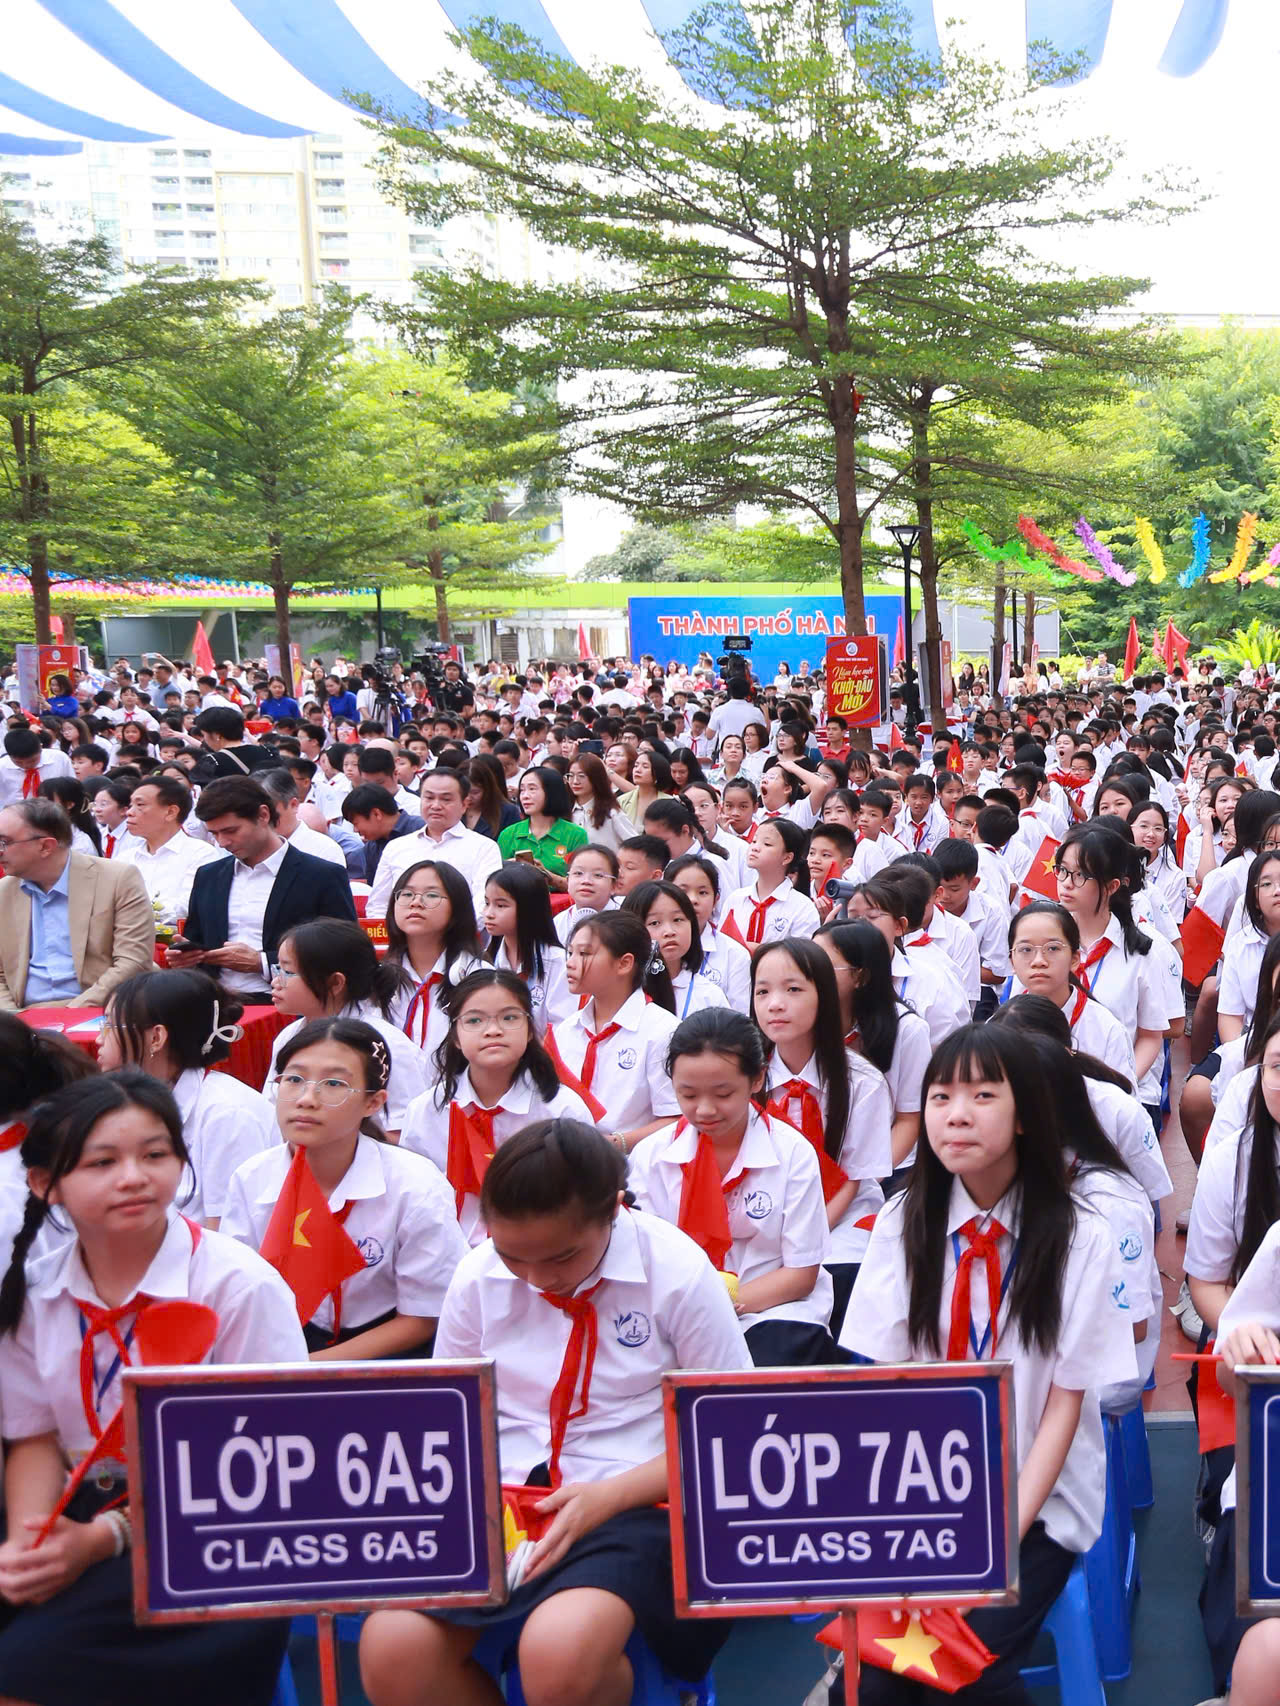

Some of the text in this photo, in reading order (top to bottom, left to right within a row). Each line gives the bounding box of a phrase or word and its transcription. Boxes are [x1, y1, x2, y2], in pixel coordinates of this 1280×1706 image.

[658, 608, 876, 635] THÀNH PHỐ HÀ NI
[177, 1416, 454, 1515] LỚP 6A5
[711, 1413, 972, 1510] LỚP 7A6
[203, 1530, 438, 1571] CLASS 6A5
[737, 1528, 957, 1566] CLASS 7A6
